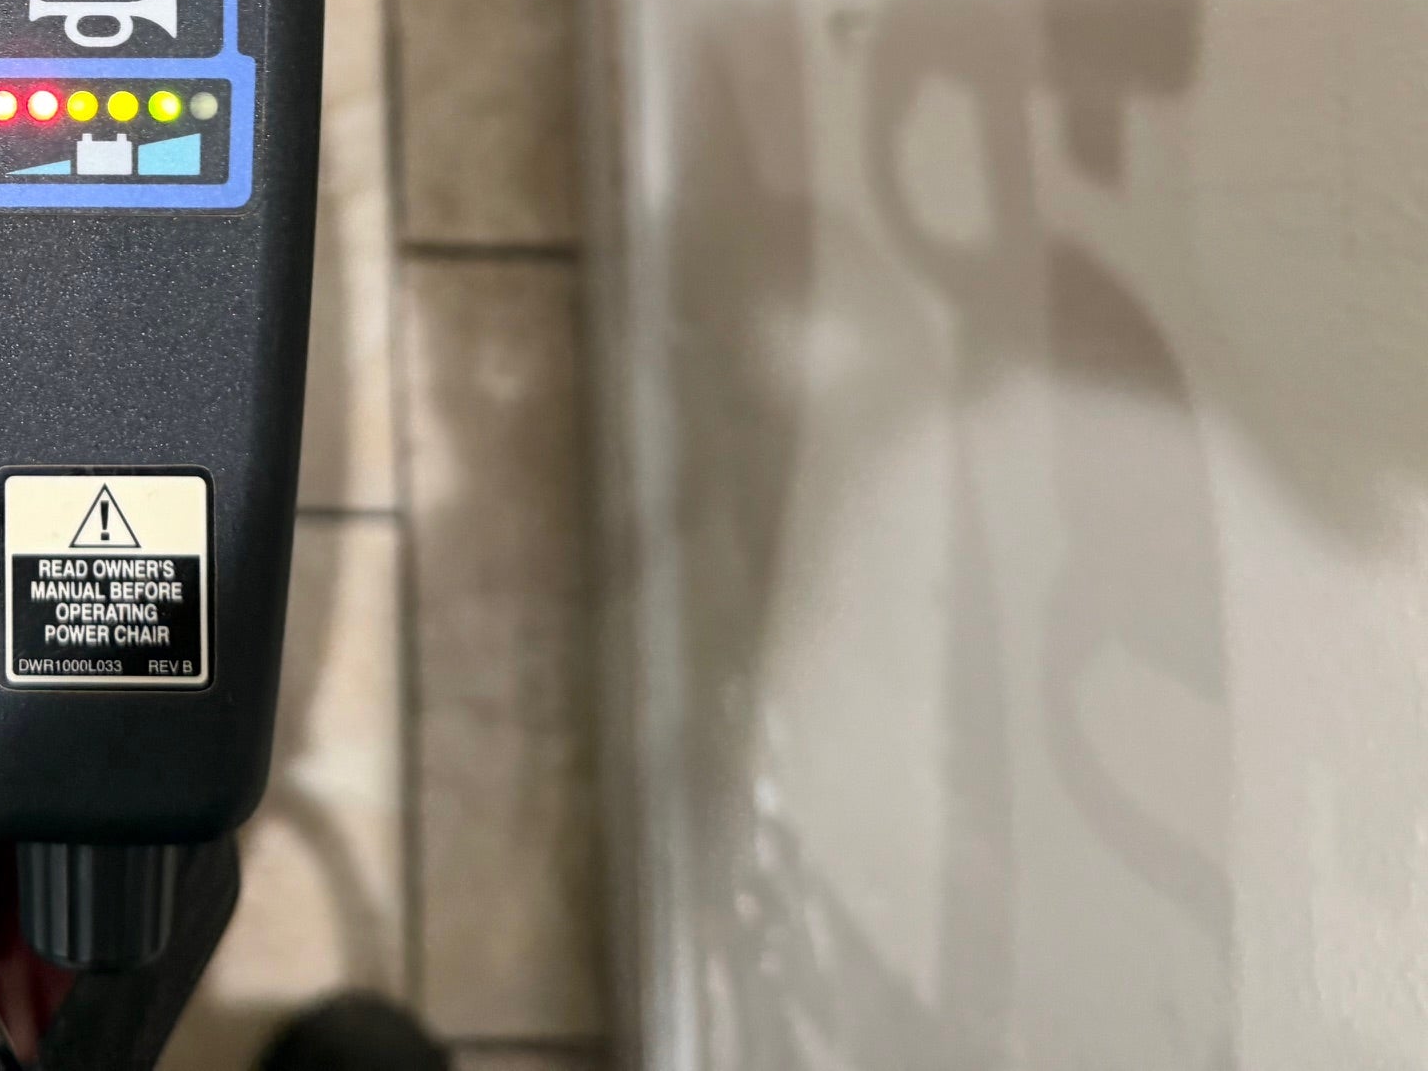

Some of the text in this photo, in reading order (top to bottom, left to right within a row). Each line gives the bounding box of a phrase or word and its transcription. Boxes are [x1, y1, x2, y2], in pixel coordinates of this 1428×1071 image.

[38, 559, 175, 579] READ OWNER'S
[30, 581, 183, 601] MANUAL BEFORE
[55, 603, 158, 622] OPERATING
[44, 625, 170, 644] POWER CHAIR
[18, 659, 193, 673] DWR1000L033 REV B
